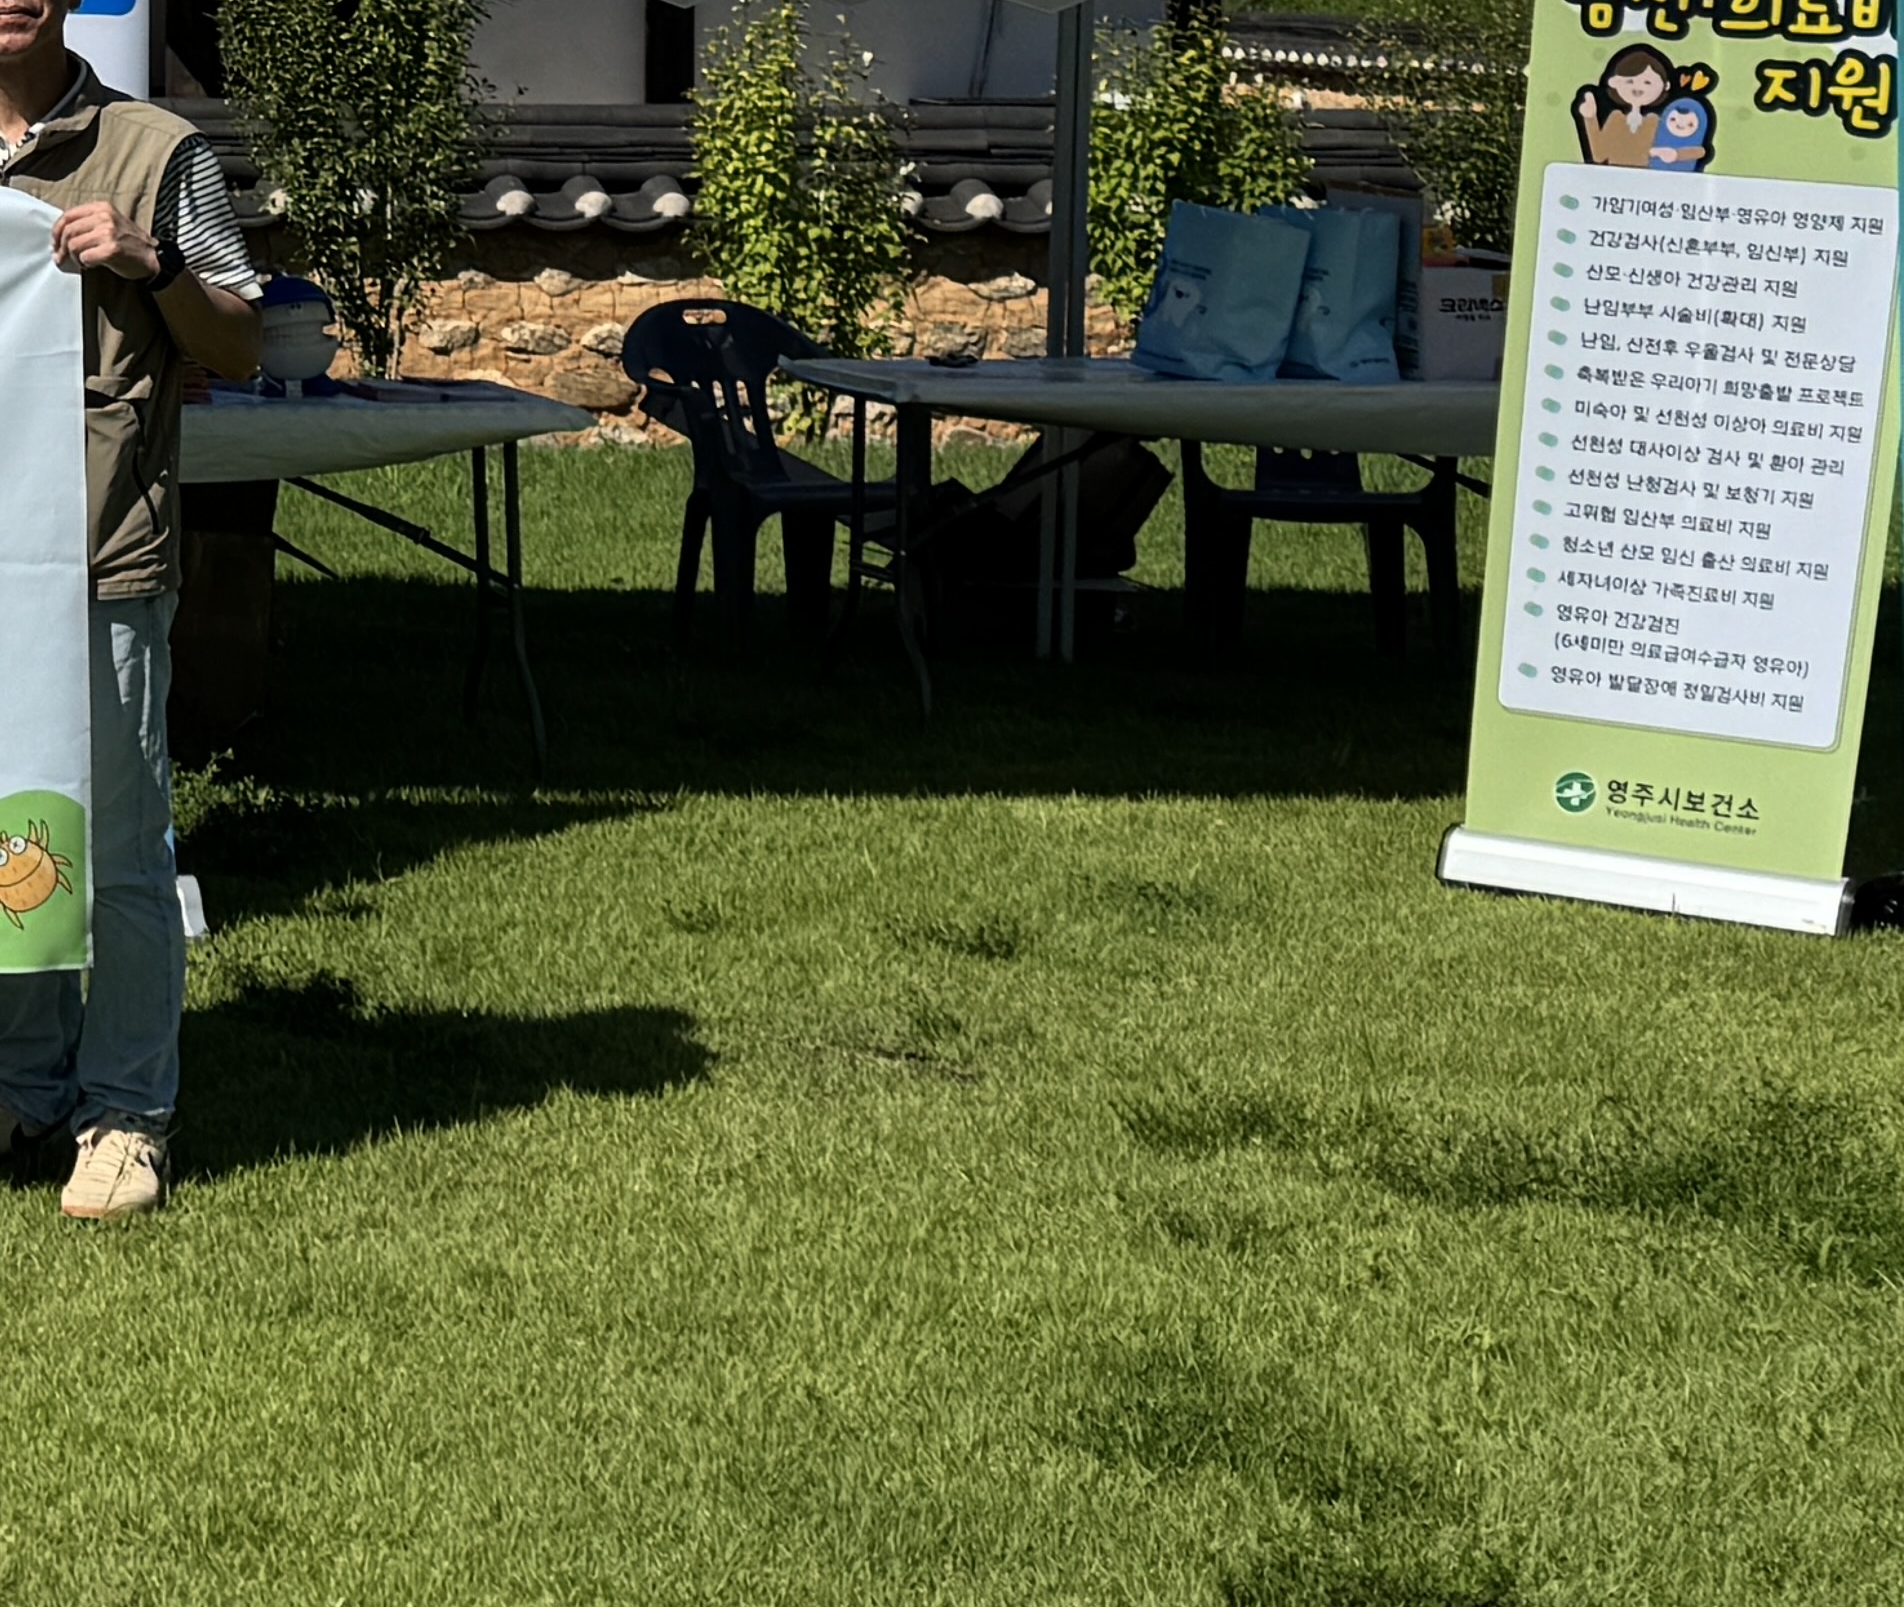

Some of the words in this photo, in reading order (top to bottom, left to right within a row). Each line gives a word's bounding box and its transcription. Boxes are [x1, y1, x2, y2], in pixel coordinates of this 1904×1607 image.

[1762, 57, 1890, 131] 지원
[1792, 211, 1845, 232] 영양제
[1850, 216, 1884, 236] 지원
[1813, 248, 1849, 268] 지원
[1687, 272, 1757, 294] 건강관리
[1764, 279, 1798, 299] 지원
[1584, 297, 1654, 319] 난임부부
[1772, 314, 1807, 334] 지원
[1581, 331, 1621, 352] 난임,
[1761, 348, 1778, 366] 및
[1784, 350, 1856, 374] 전문상담
[1650, 372, 1718, 395] 우리아기
[1723, 380, 1793, 403] 희망출발
[1797, 387, 1863, 407] 프로젝트
[1574, 399, 1627, 421] 미숙아
[1633, 405, 1650, 423] 및
[1655, 408, 1708, 429] 선천성
[1713, 414, 1766, 435] 이상아
[1771, 419, 1824, 440] 의료비
[1829, 424, 1863, 444] 지원
[1571, 434, 1623, 455] 선천성
[1629, 439, 1701, 463] 대사이상
[1706, 447, 1741, 467] 검사
[1747, 451, 1764, 470] 및
[1769, 454, 1804, 474] 환아
[1811, 457, 1845, 476] 관리
[1568, 468, 1620, 490] 선천성
[1626, 474, 1696, 497] 난청검사
[1703, 481, 1720, 500] 및
[1725, 485, 1775, 505] 보청기
[1781, 490, 1814, 510] 지원
[1564, 502, 1616, 524] 고위험
[1623, 507, 1675, 529] 임산부
[1681, 515, 1733, 535] 의료비
[1738, 520, 1771, 541] 지원
[1563, 535, 1614, 559] 청소년
[1620, 543, 1654, 561] 산모
[1661, 546, 1695, 568] 임신
[1701, 550, 1735, 572] 출산
[1740, 555, 1791, 576] 의료비
[1796, 561, 1829, 581] 지원
[1558, 570, 1647, 596] 세자녀이상
[1742, 591, 1775, 611] 지원
[1556, 603, 1608, 626] 영유아
[1614, 610, 1680, 636] 건강검진
[1629, 641, 1746, 670] 의료급여수급자
[1550, 665, 1602, 688] 영유아
[1771, 693, 1804, 713] 지원
[1606, 779, 1760, 821] 영주시보건소
